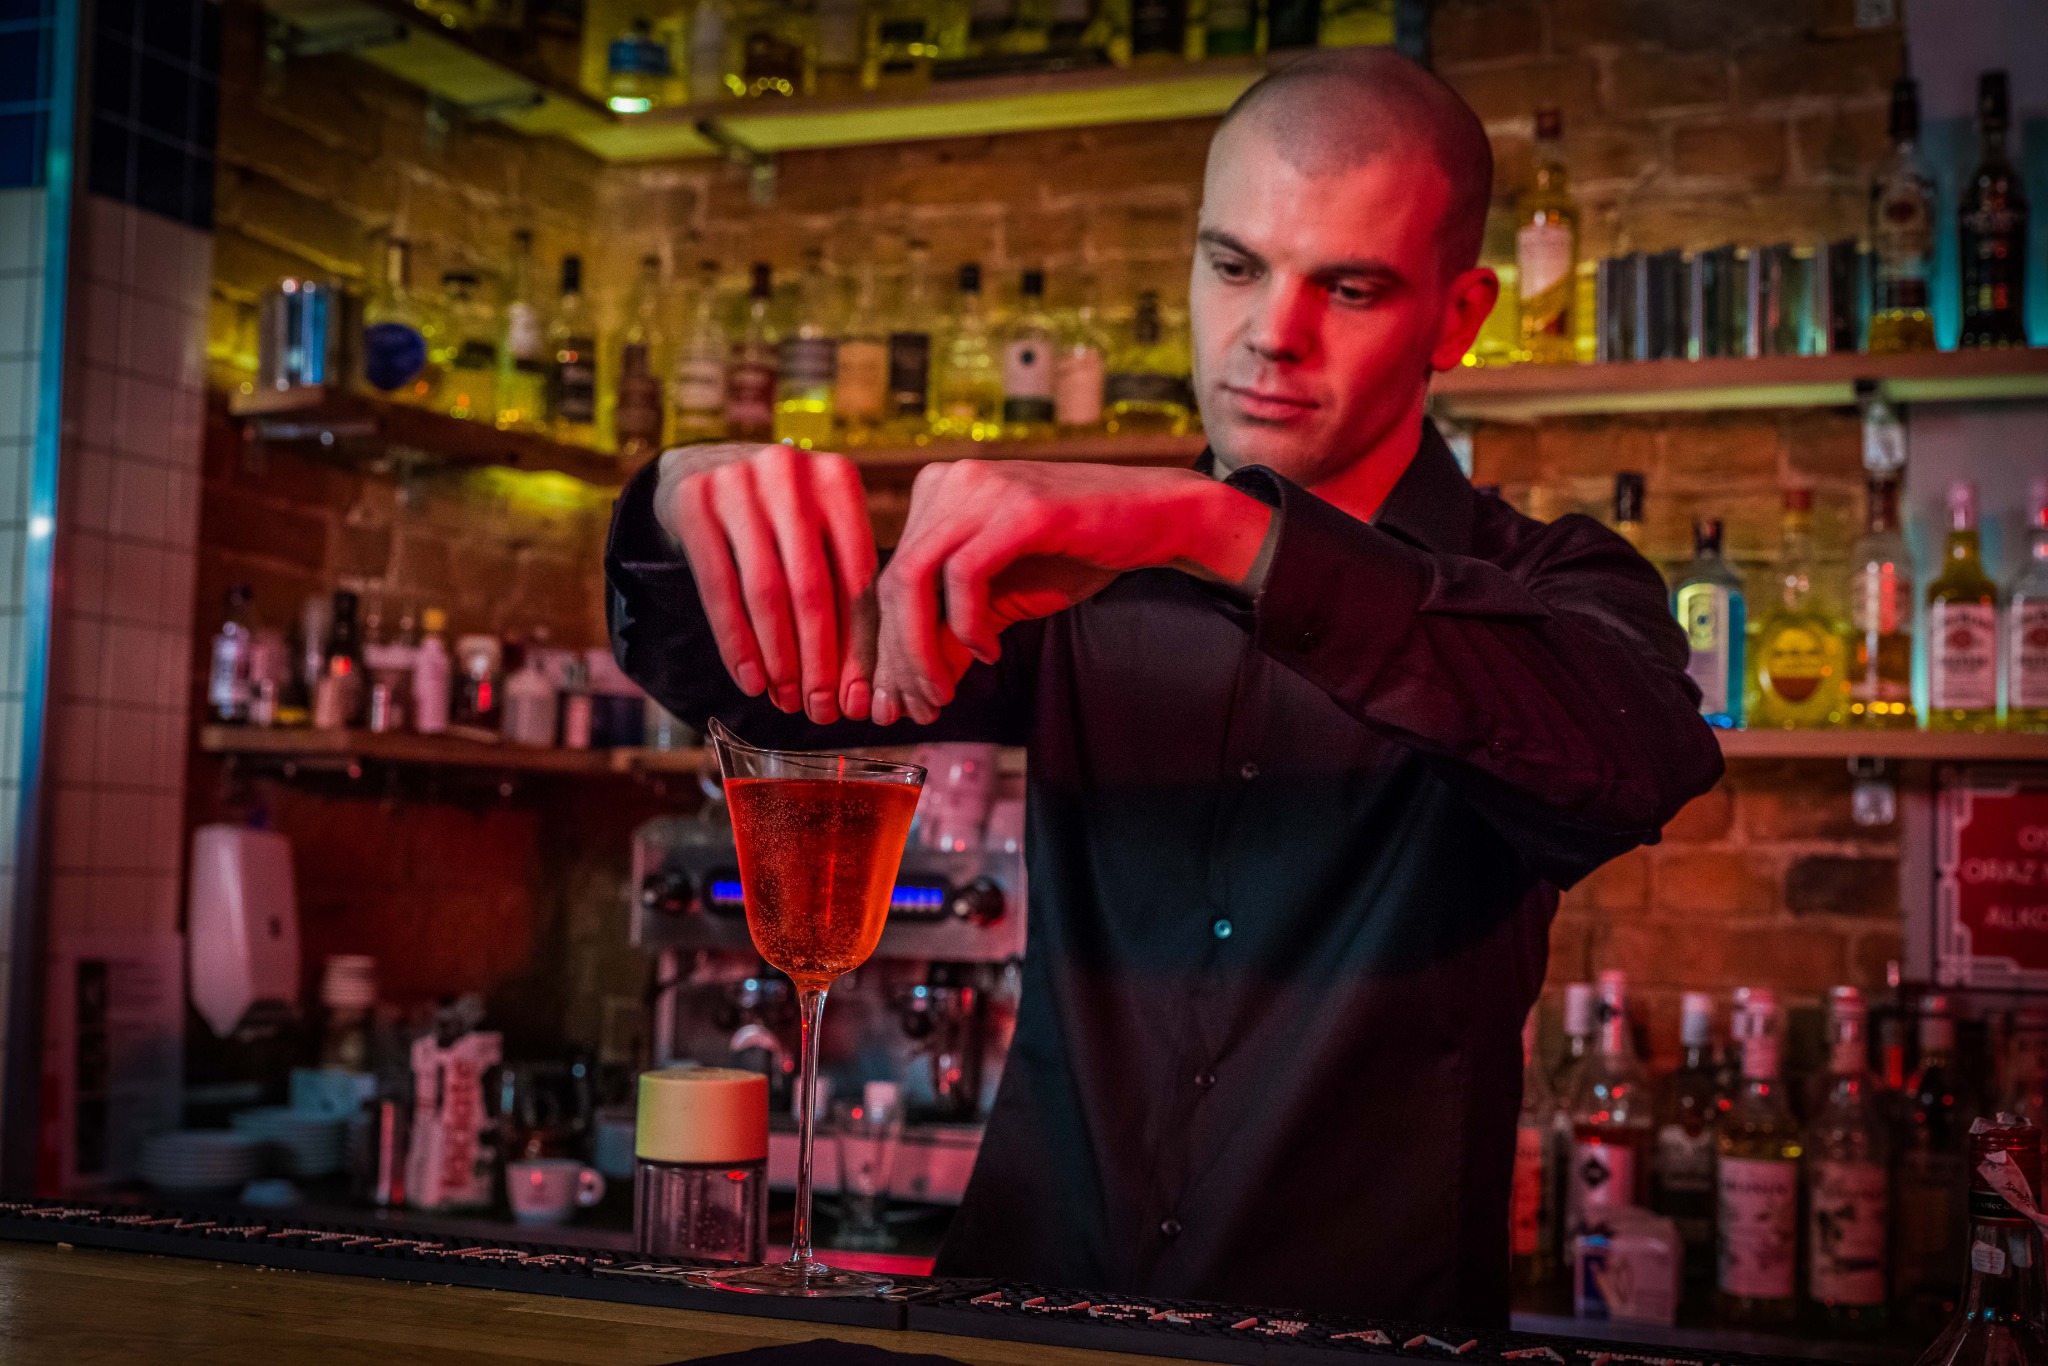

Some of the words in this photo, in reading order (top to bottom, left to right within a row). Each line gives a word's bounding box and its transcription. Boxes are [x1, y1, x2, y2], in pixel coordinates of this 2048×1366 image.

[1961, 856, 2038, 886] ORAZ
[970, 1291, 1213, 1325] LUCK
[1330, 1330, 1478, 1355] AN
